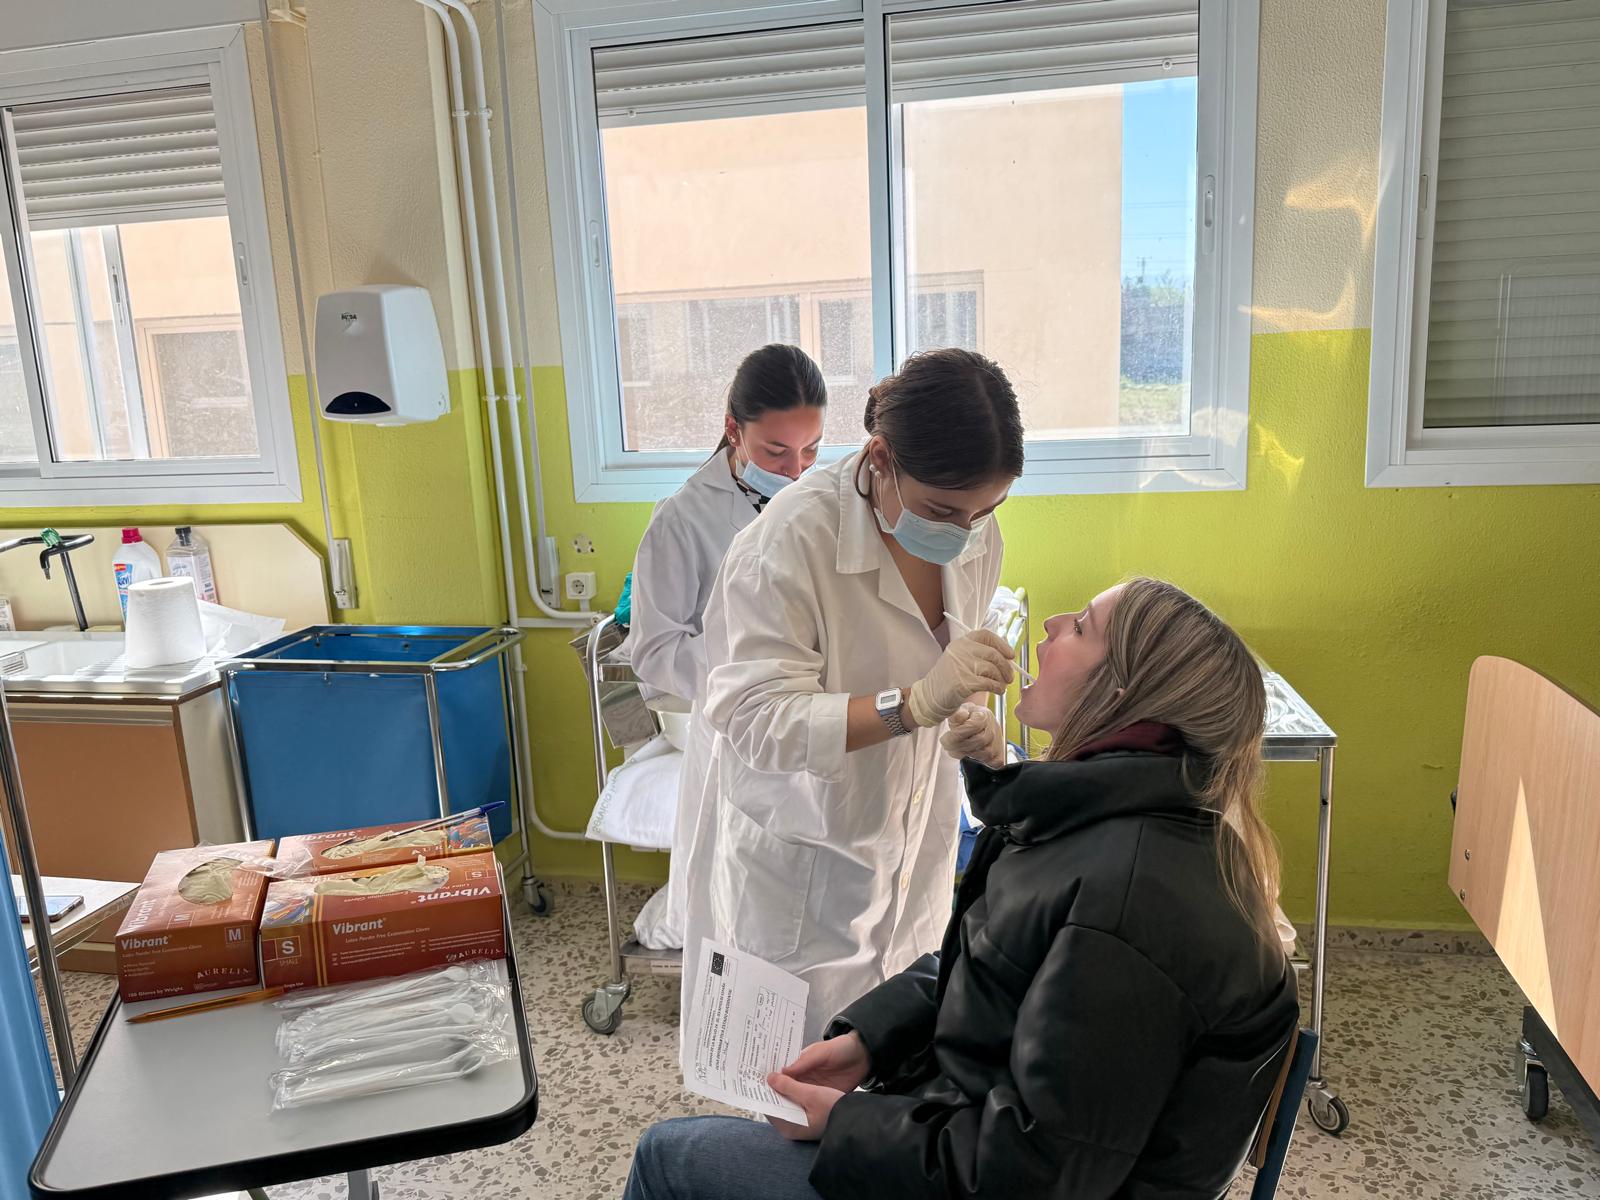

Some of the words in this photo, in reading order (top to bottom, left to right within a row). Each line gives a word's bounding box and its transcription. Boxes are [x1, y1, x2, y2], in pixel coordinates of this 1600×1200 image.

[418, 886, 491, 900] Vibrant
[126, 899, 156, 932] Vibrant
[174, 913, 191, 922] M
[332, 918, 384, 936] Vibrant
[121, 935, 169, 950] Vibrant
[228, 928, 241, 942] M
[281, 940, 295, 955] S
